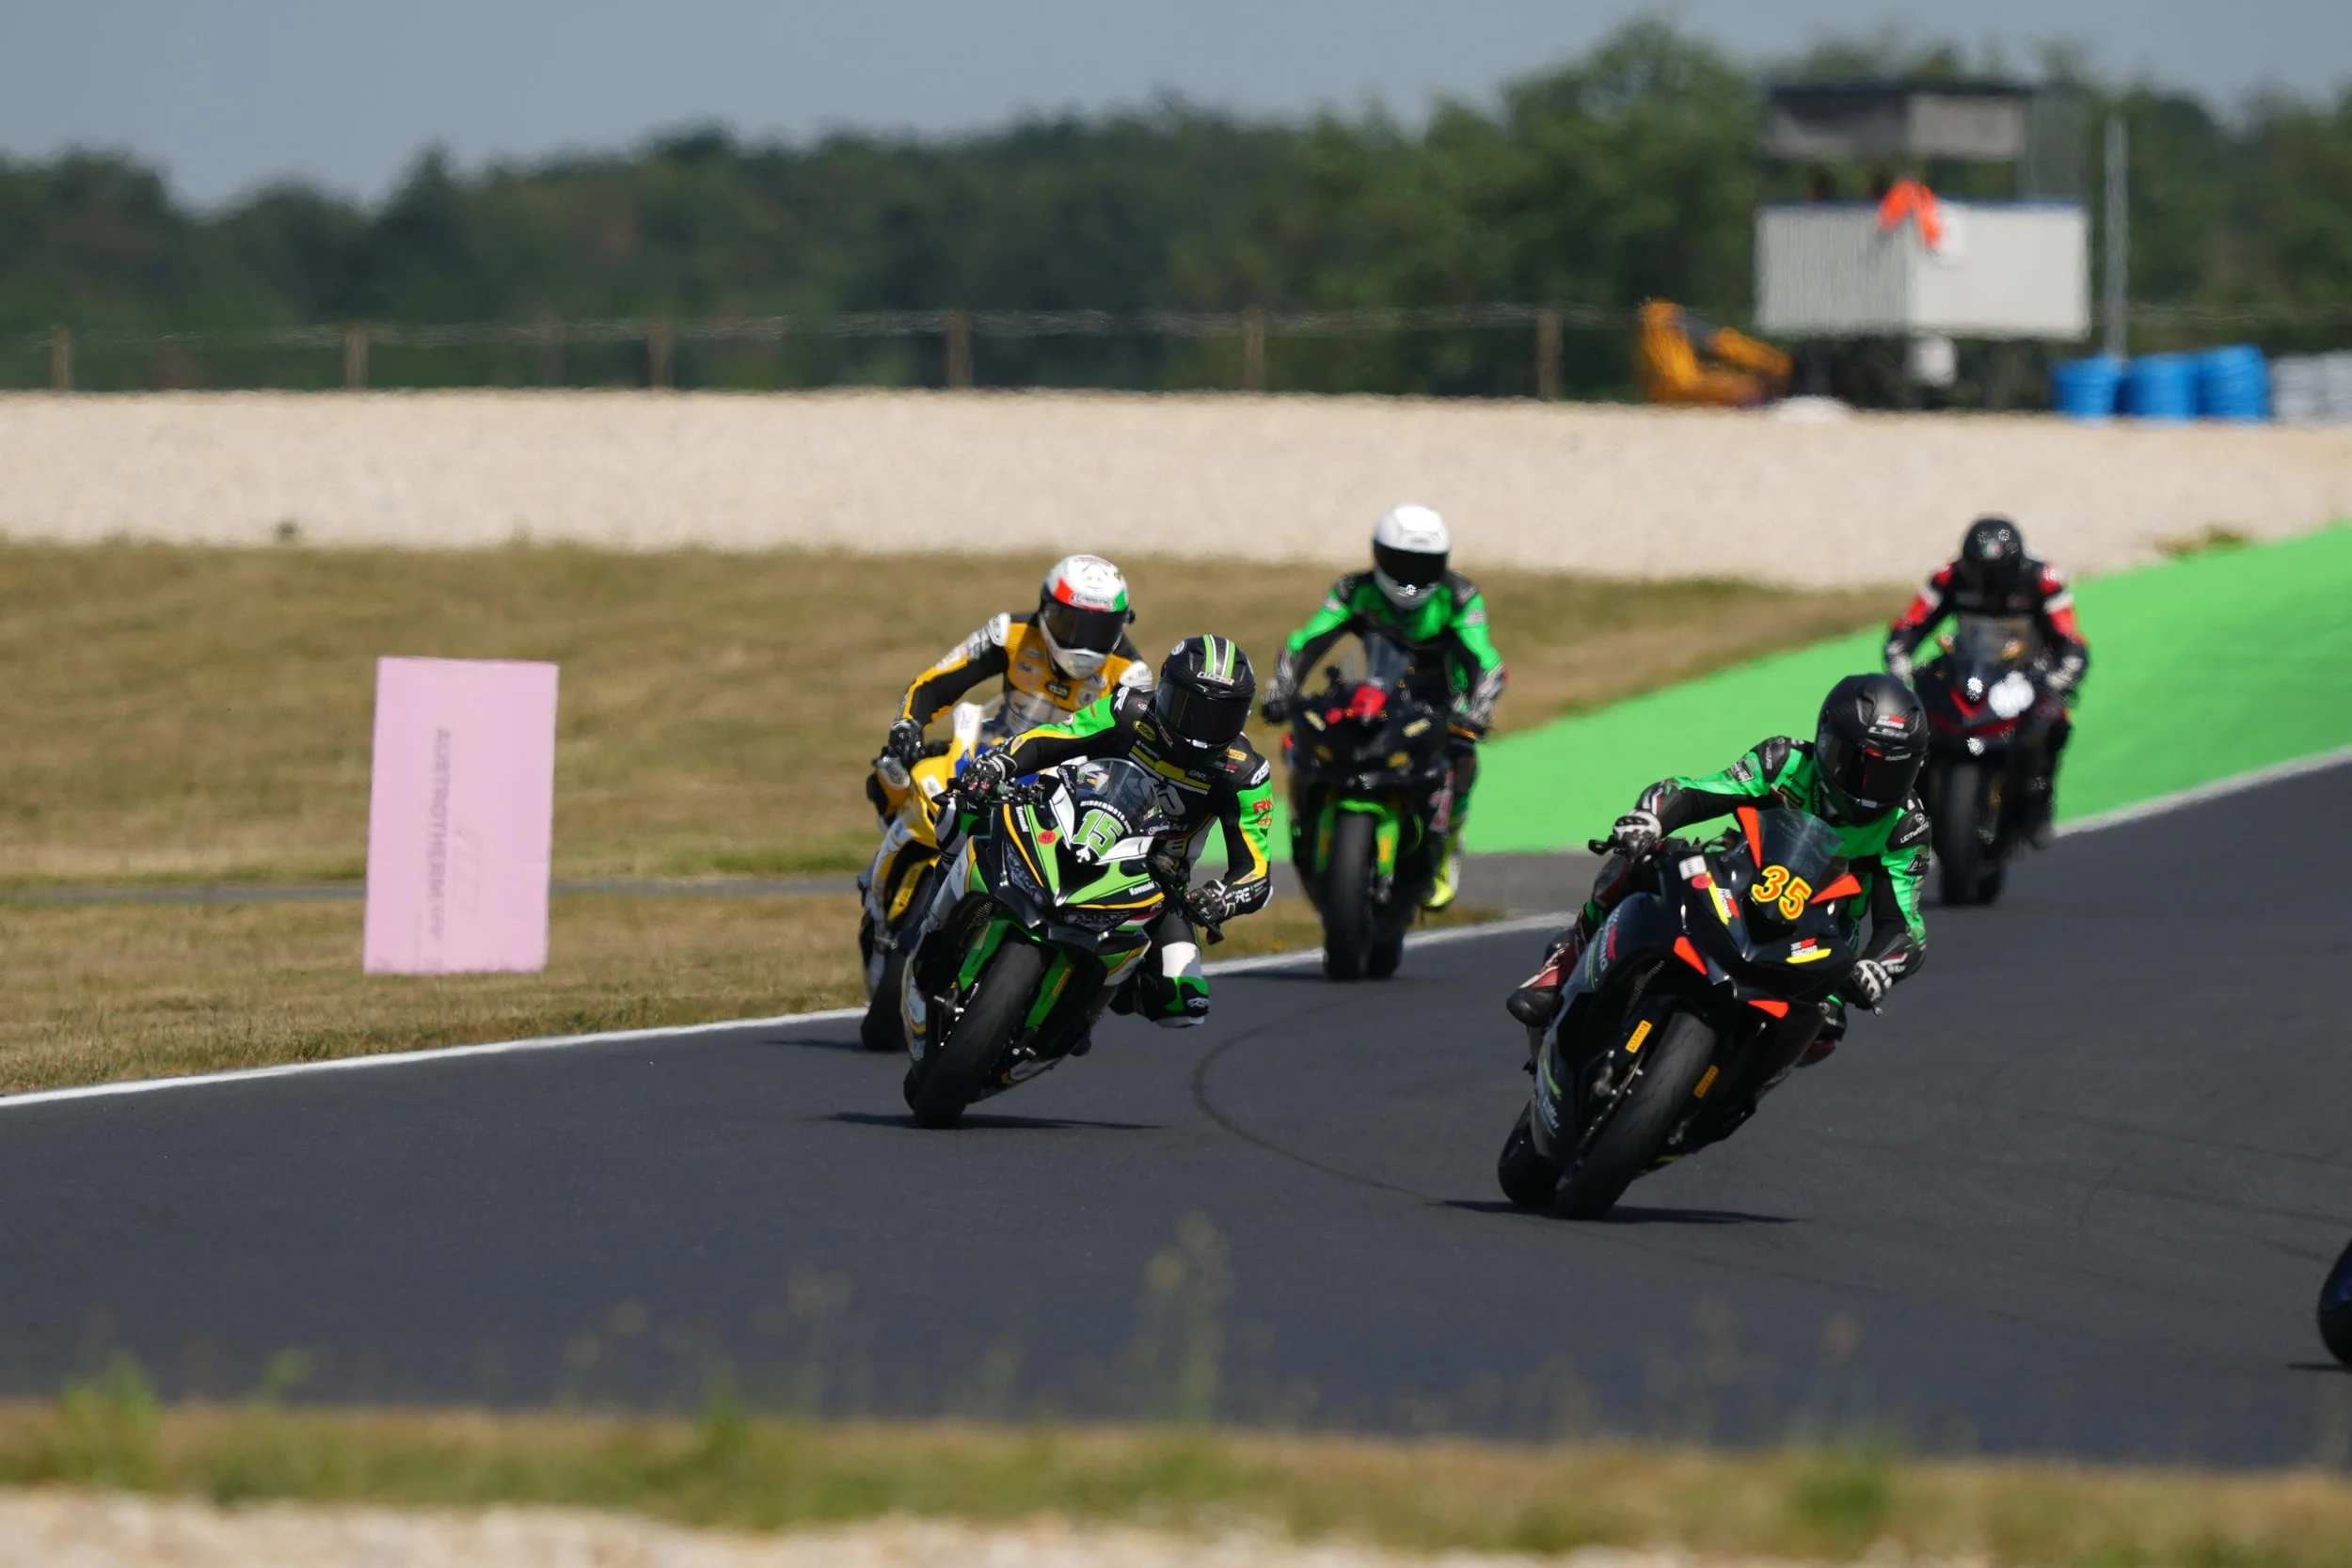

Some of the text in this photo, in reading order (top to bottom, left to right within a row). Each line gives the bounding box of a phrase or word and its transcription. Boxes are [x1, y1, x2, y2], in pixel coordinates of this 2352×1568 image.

[428, 728, 451, 898] AUSTROTHERM
[1016, 805, 1030, 832] Kawasaki
[1071, 809, 1124, 858] 15
[1129, 880, 1156, 896] Kawasaki
[1751, 864, 1813, 920] 35
